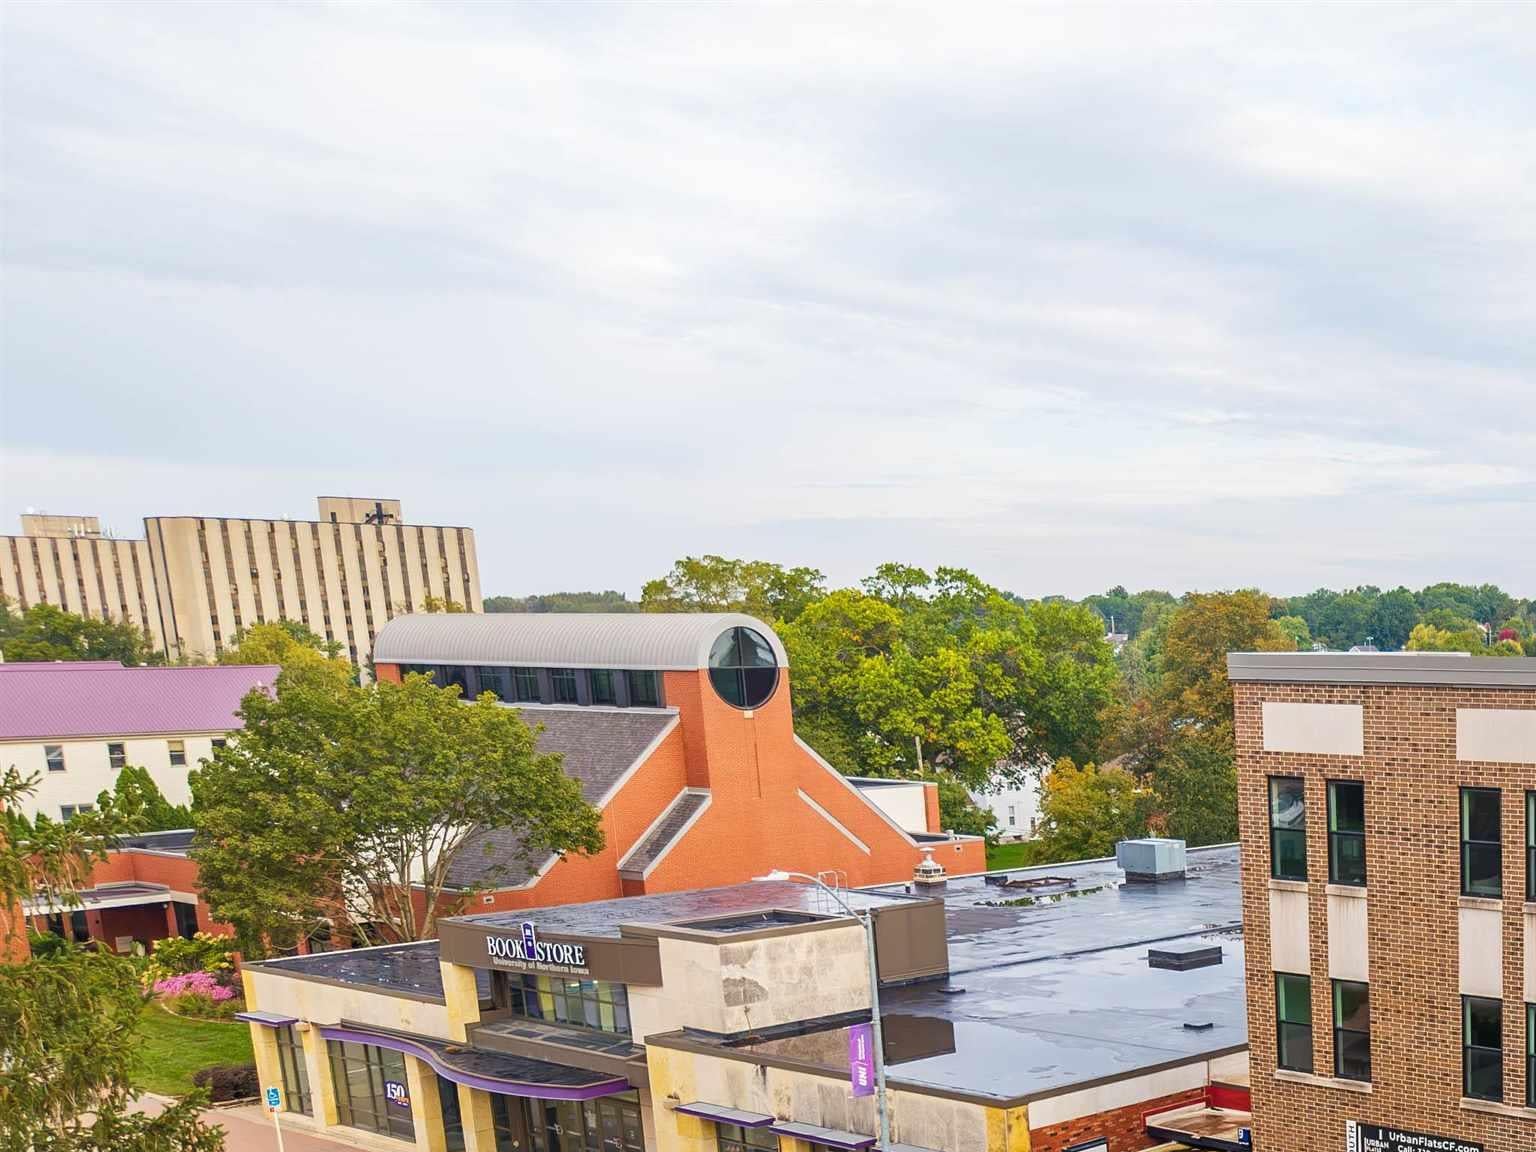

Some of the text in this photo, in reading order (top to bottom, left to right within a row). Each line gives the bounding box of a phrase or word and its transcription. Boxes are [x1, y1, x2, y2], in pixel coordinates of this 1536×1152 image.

[486, 936, 585, 965] BOOK STORE
[493, 956, 590, 975] University of Northern Iowa
[386, 1082, 405, 1099] 150
[1366, 1139, 1389, 1149] URBAN
